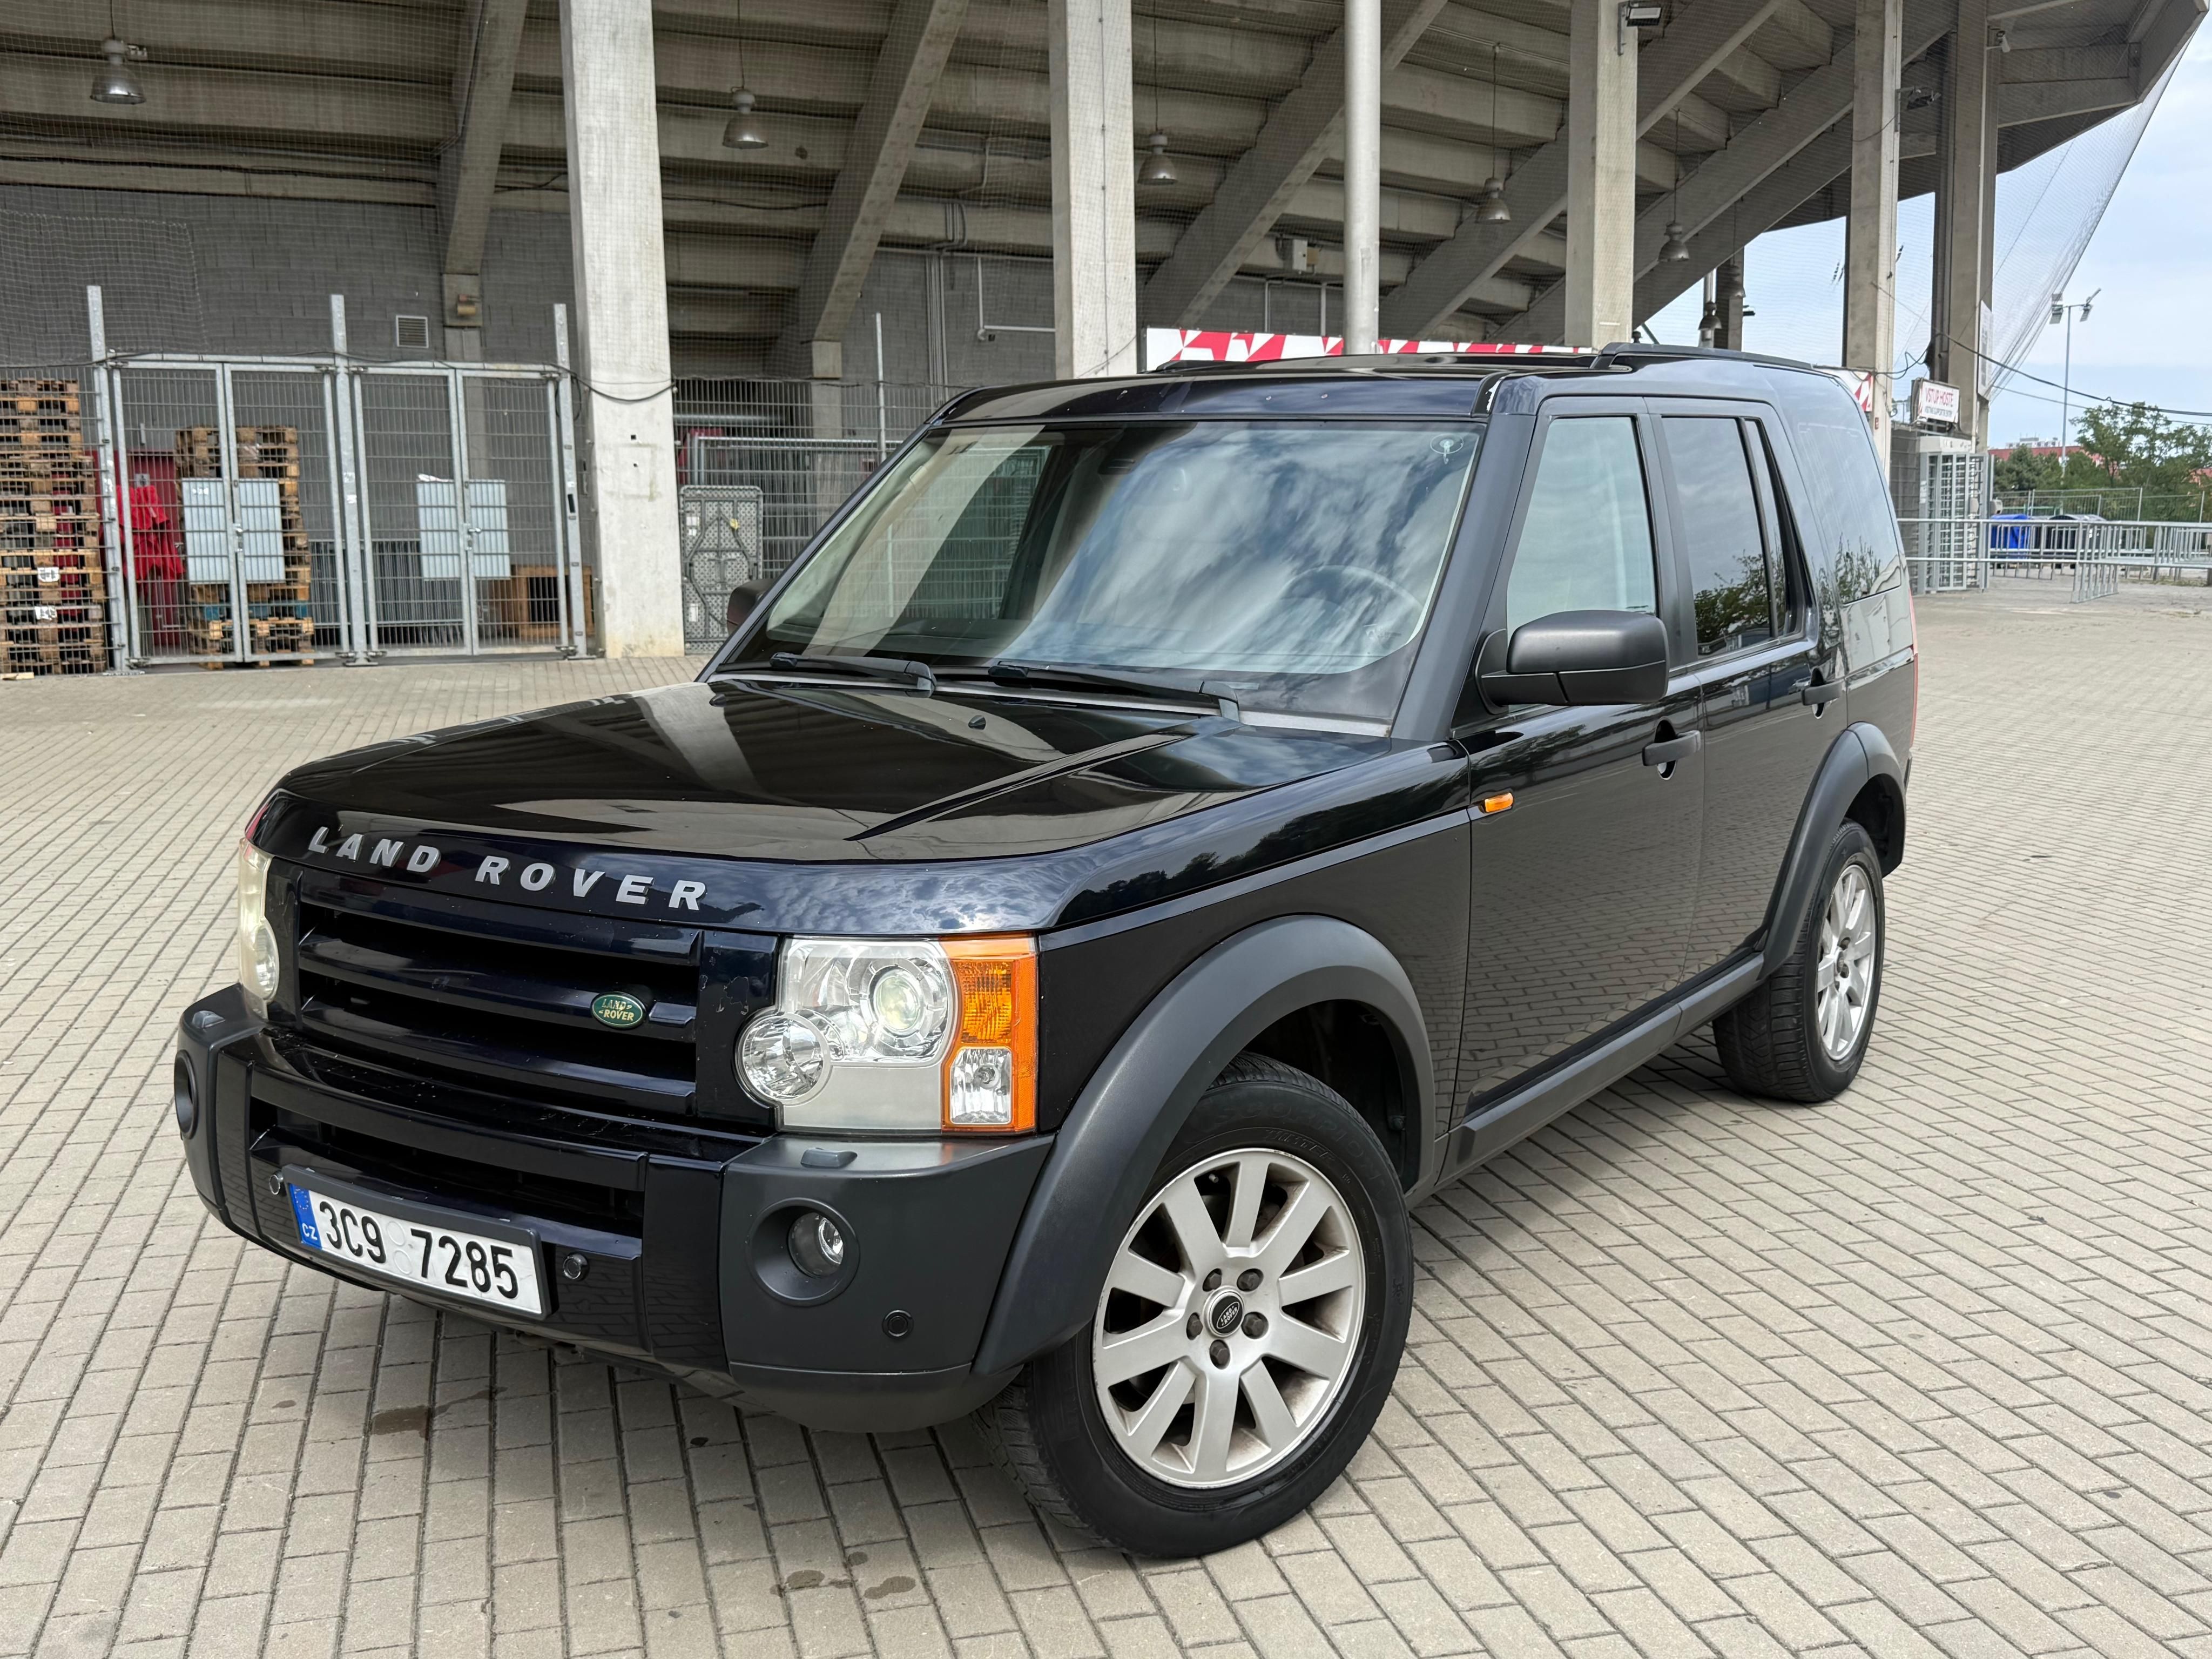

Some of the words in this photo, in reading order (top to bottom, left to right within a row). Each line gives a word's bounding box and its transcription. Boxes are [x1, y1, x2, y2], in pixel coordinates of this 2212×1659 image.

[308, 826, 442, 873] LAND
[474, 855, 706, 911] ROVER
[602, 999, 626, 1010] LAND
[604, 1009, 635, 1021] ROVER
[302, 1223, 318, 1240] CZ
[320, 1201, 386, 1264] 3C9
[410, 1228, 518, 1299] 7285
[1224, 1306, 1237, 1324] ROVER
